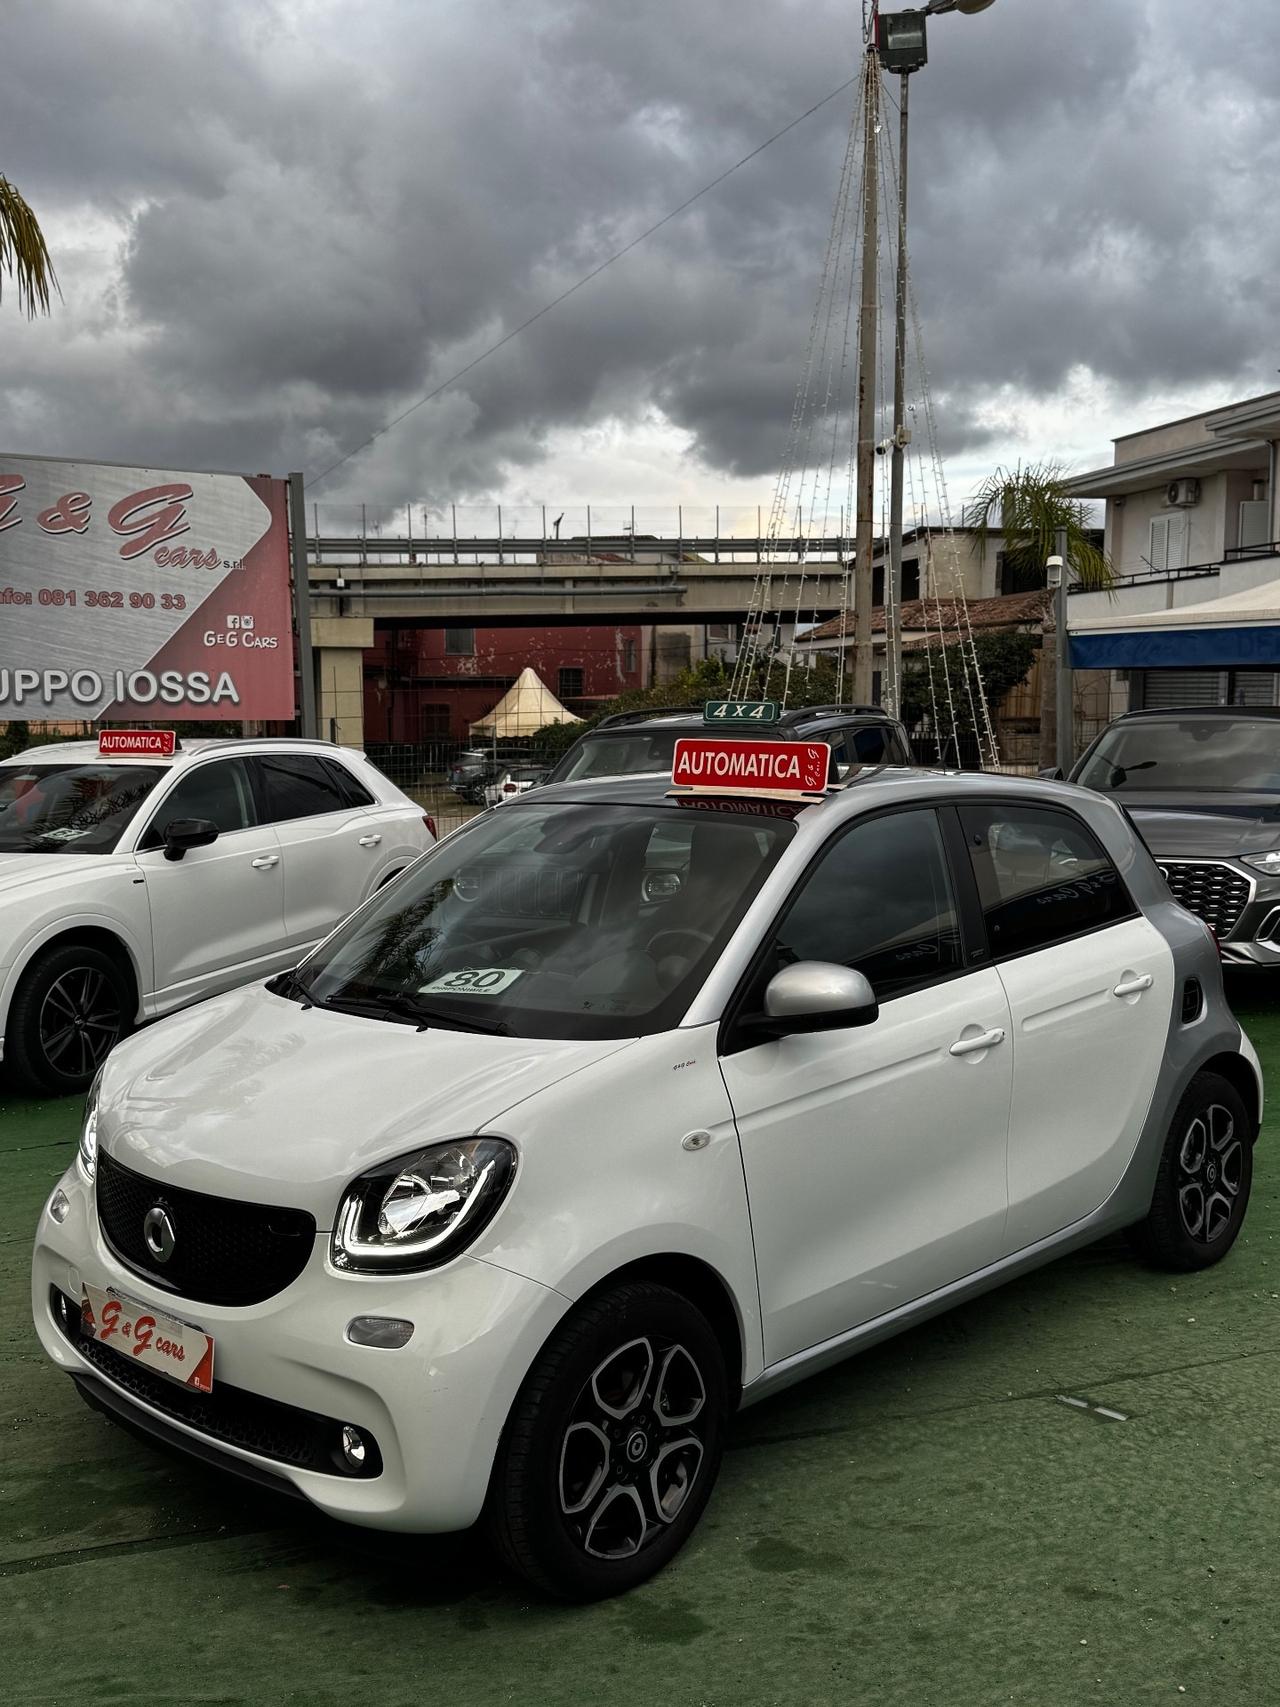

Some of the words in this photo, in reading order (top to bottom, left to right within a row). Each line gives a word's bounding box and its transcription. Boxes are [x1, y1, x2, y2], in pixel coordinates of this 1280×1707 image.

[36, 491, 93, 534] &
[154, 545, 222, 570] cars
[0, 587, 32, 605] fo:
[38, 588, 76, 606] 081
[85, 591, 124, 608] 362
[129, 592, 155, 609] 90
[160, 593, 186, 610] 33
[116, 670, 240, 704] IOSSA
[101, 736, 162, 749] AUTOMATICA
[677, 751, 801, 779] AUTOMATICA
[444, 971, 506, 988] 80
[100, 1300, 123, 1341] G
[132, 1315, 156, 1357] G
[156, 1336, 186, 1362] cars
